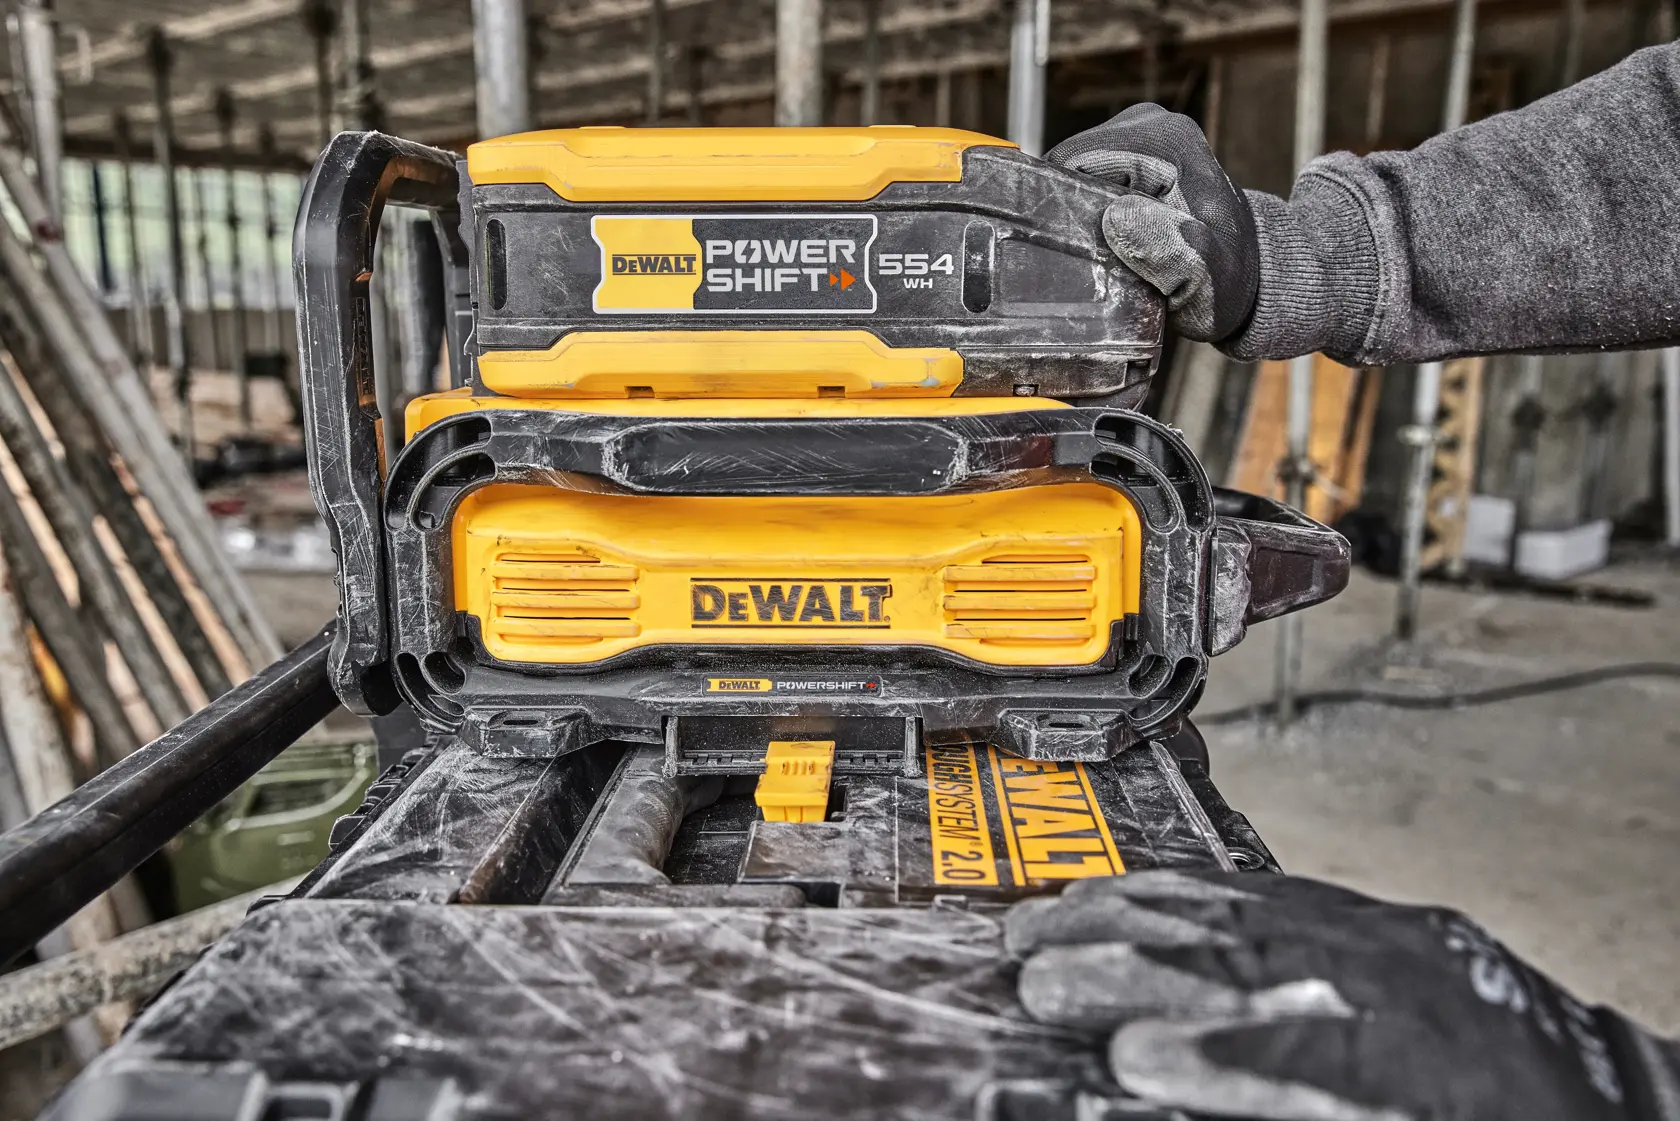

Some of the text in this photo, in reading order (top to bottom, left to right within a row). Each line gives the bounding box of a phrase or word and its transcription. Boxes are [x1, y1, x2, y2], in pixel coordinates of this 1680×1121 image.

[706, 239, 856, 264] POWER
[879, 253, 954, 275] 554
[706, 267, 828, 292] SHIFT
[903, 277, 933, 289] WH
[776, 680, 866, 690] POWERSHIFT
[931, 742, 986, 880] OUGHSYSTEM 2.0
